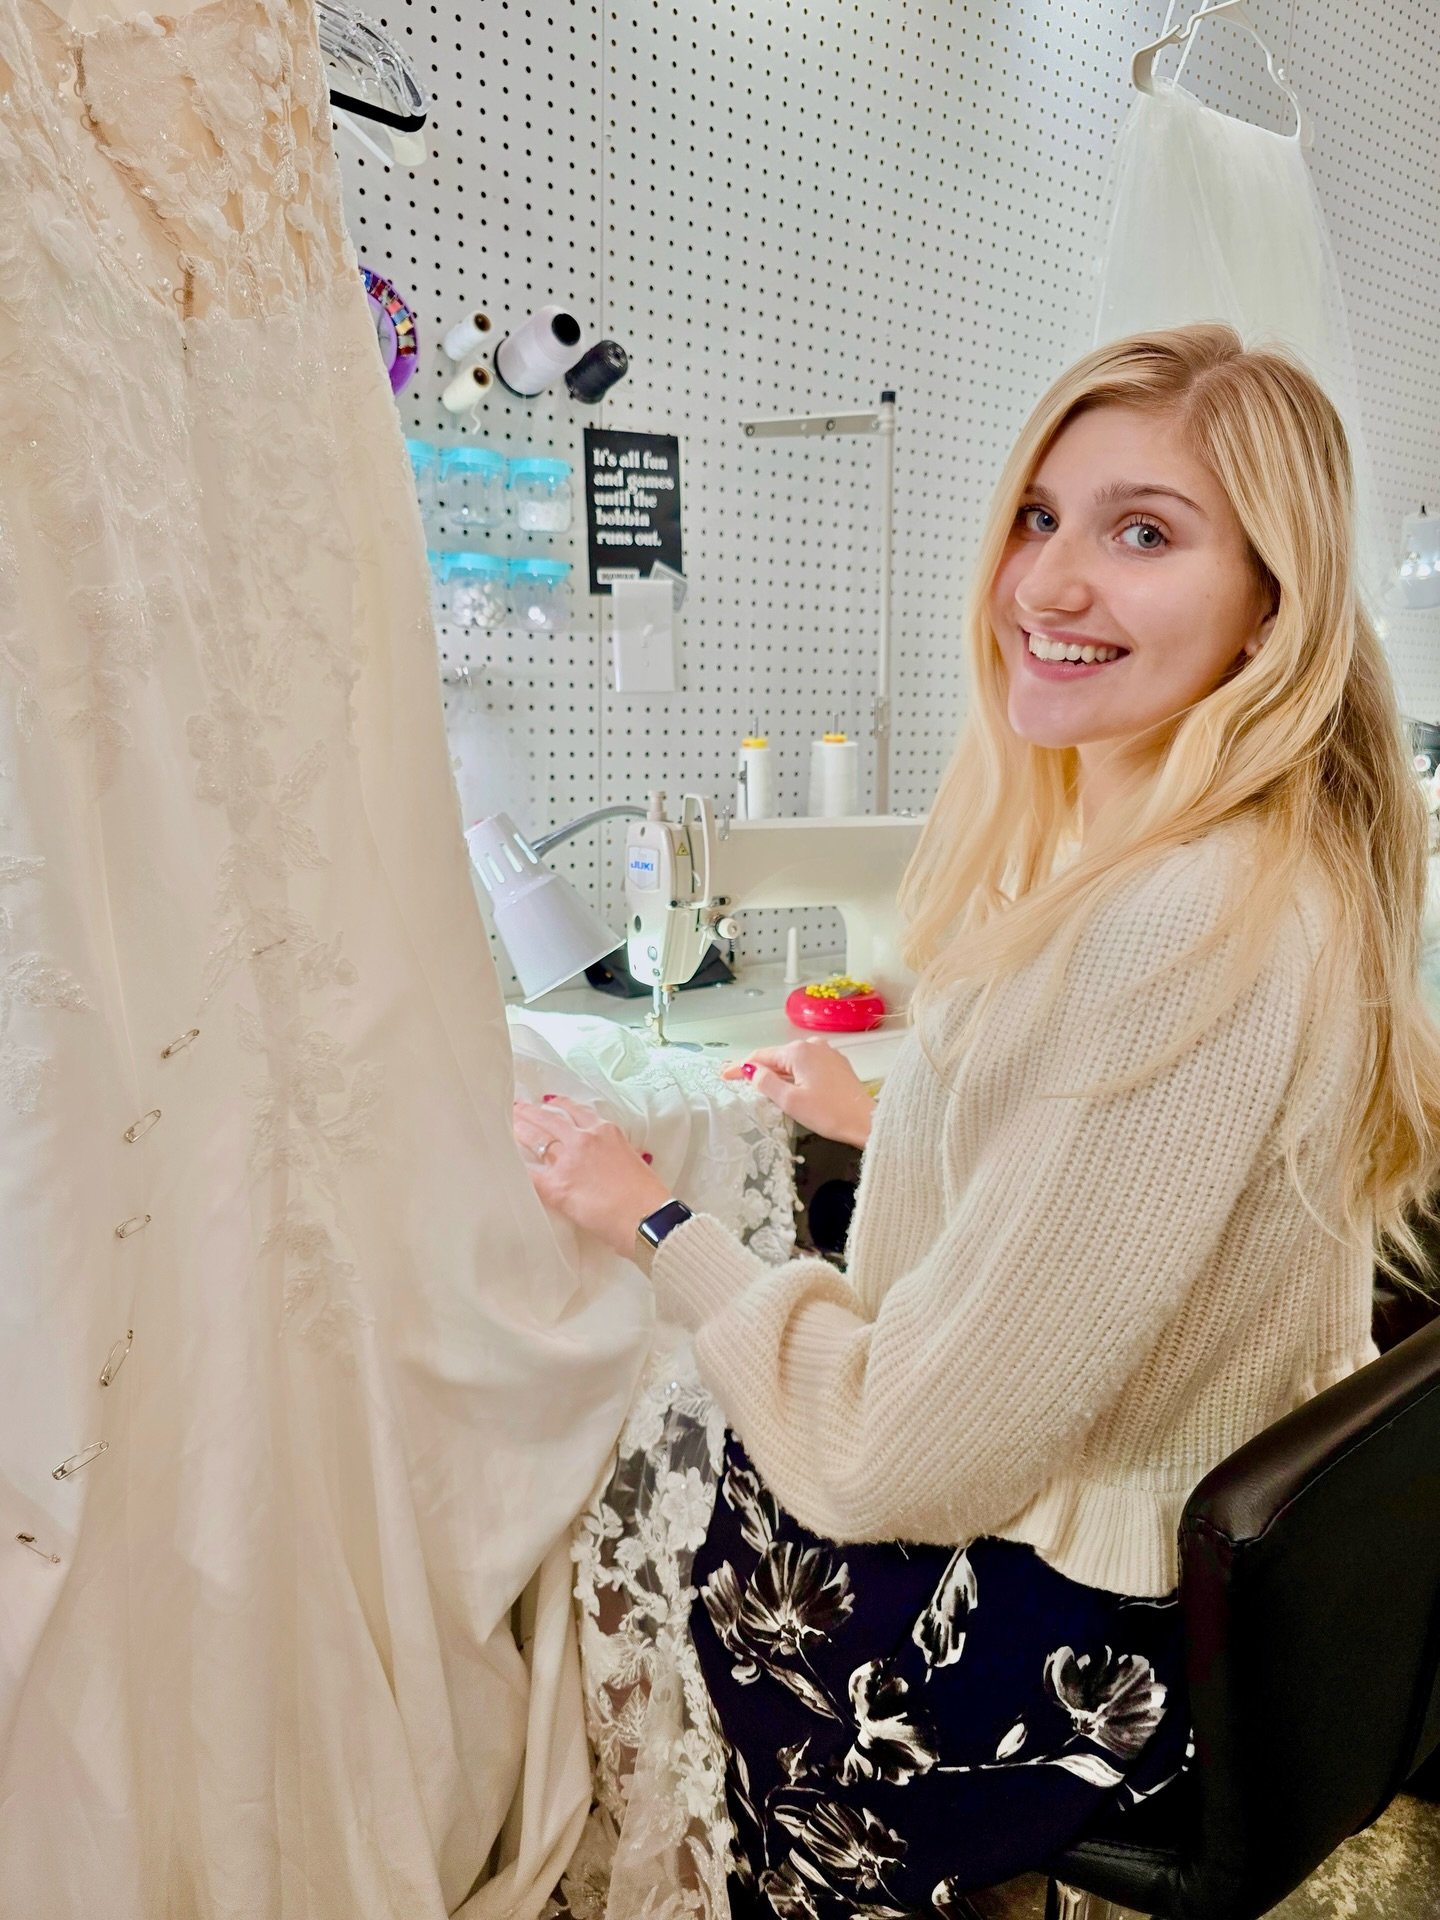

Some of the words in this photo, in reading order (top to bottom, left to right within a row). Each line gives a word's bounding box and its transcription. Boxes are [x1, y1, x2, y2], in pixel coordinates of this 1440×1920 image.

[593, 448, 617, 467] It's
[619, 450, 640, 469] all
[643, 450, 668, 470] fun
[594, 469, 623, 487] and
[627, 474, 674, 495] games
[594, 490, 630, 506] until
[633, 490, 657, 508] the
[596, 507, 650, 527] bobbin
[597, 531, 633, 546] runs
[634, 530, 662, 546] out.
[630, 860, 654, 871] JUKI
